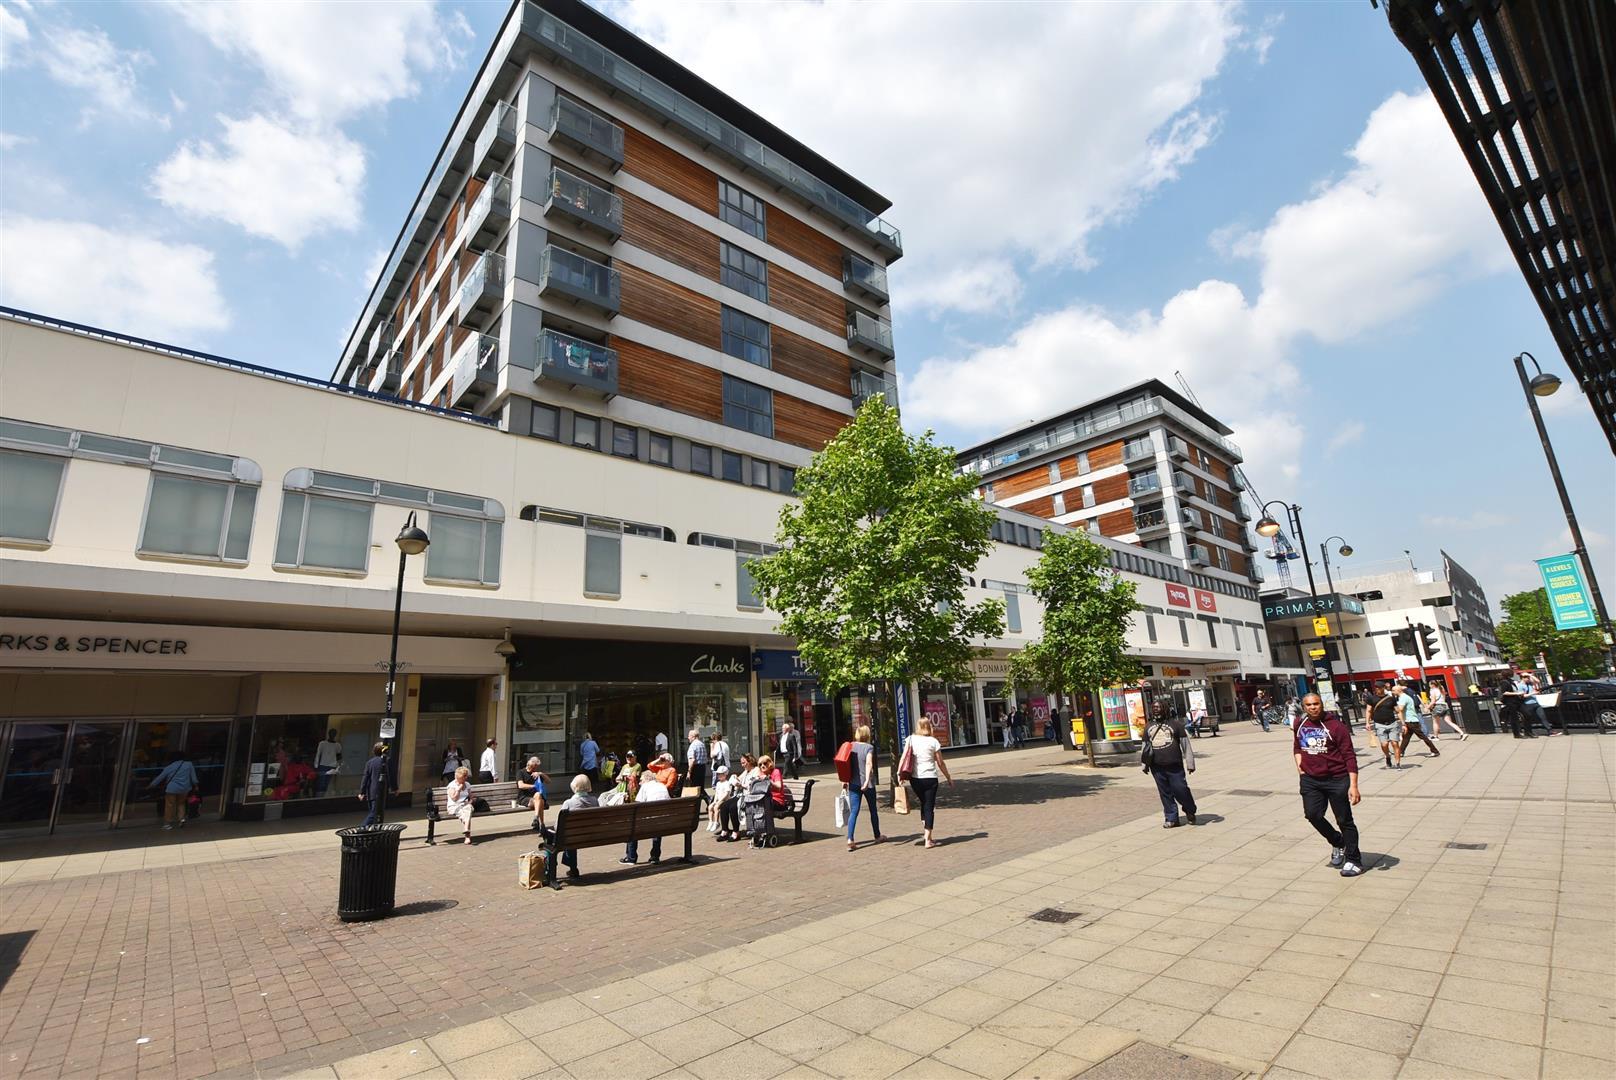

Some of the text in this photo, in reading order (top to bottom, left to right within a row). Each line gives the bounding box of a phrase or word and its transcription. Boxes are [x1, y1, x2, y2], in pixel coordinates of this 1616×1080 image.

[1551, 564, 1572, 572] LEVELS
[1265, 600, 1334, 617] PRIMARK
[0, 634, 188, 655] RKS & SPENCER
[690, 654, 745, 673] Clarks
